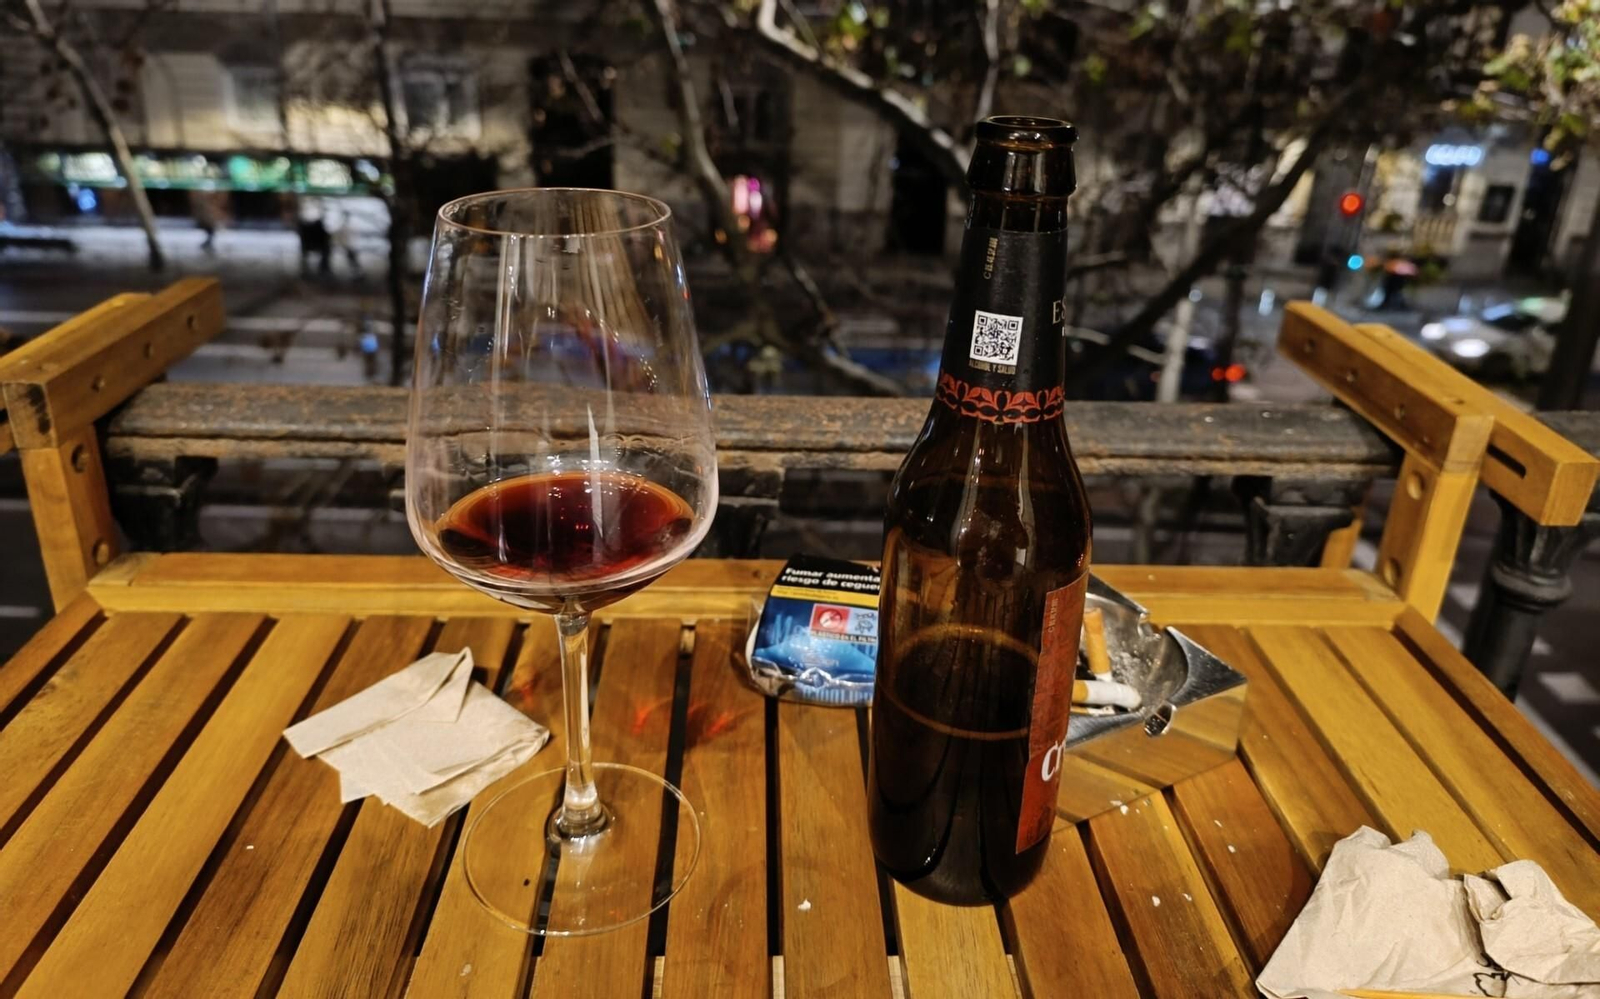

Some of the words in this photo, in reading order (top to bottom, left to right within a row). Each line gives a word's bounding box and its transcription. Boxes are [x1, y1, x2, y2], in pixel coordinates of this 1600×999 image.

[781, 575, 820, 585] riesgo
[822, 578, 839, 587] de
[785, 567, 824, 578] Fumar
[826, 571, 880, 583] aumenta
